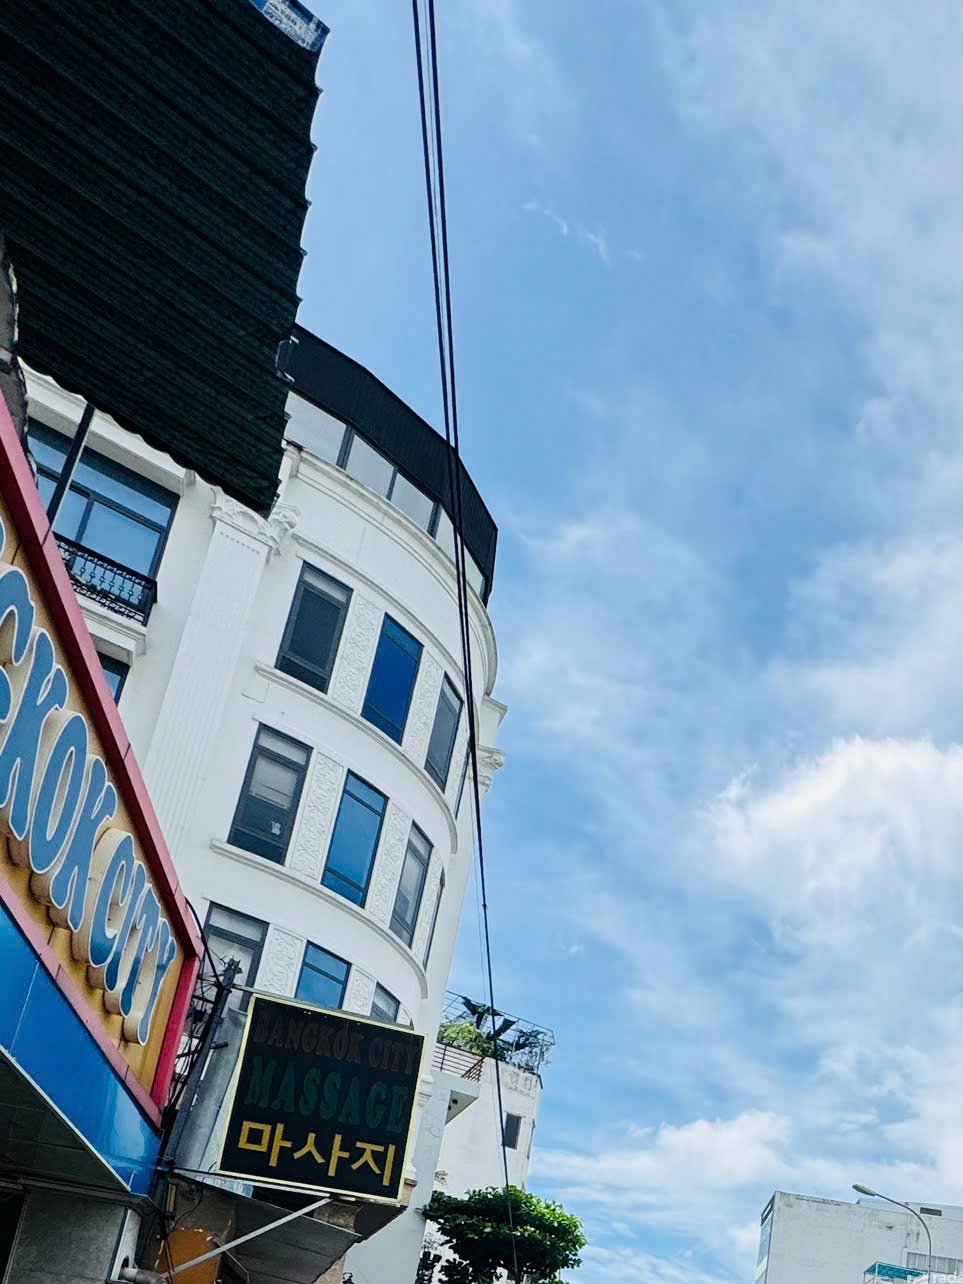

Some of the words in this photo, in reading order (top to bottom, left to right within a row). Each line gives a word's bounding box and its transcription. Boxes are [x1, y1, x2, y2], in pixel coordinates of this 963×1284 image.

[89, 834, 176, 1045] CITY
[253, 1011, 364, 1064] BANGKOK
[368, 1036, 416, 1075] CITY
[244, 1056, 408, 1133] MASSAGE
[238, 1120, 396, 1186] 마사지
